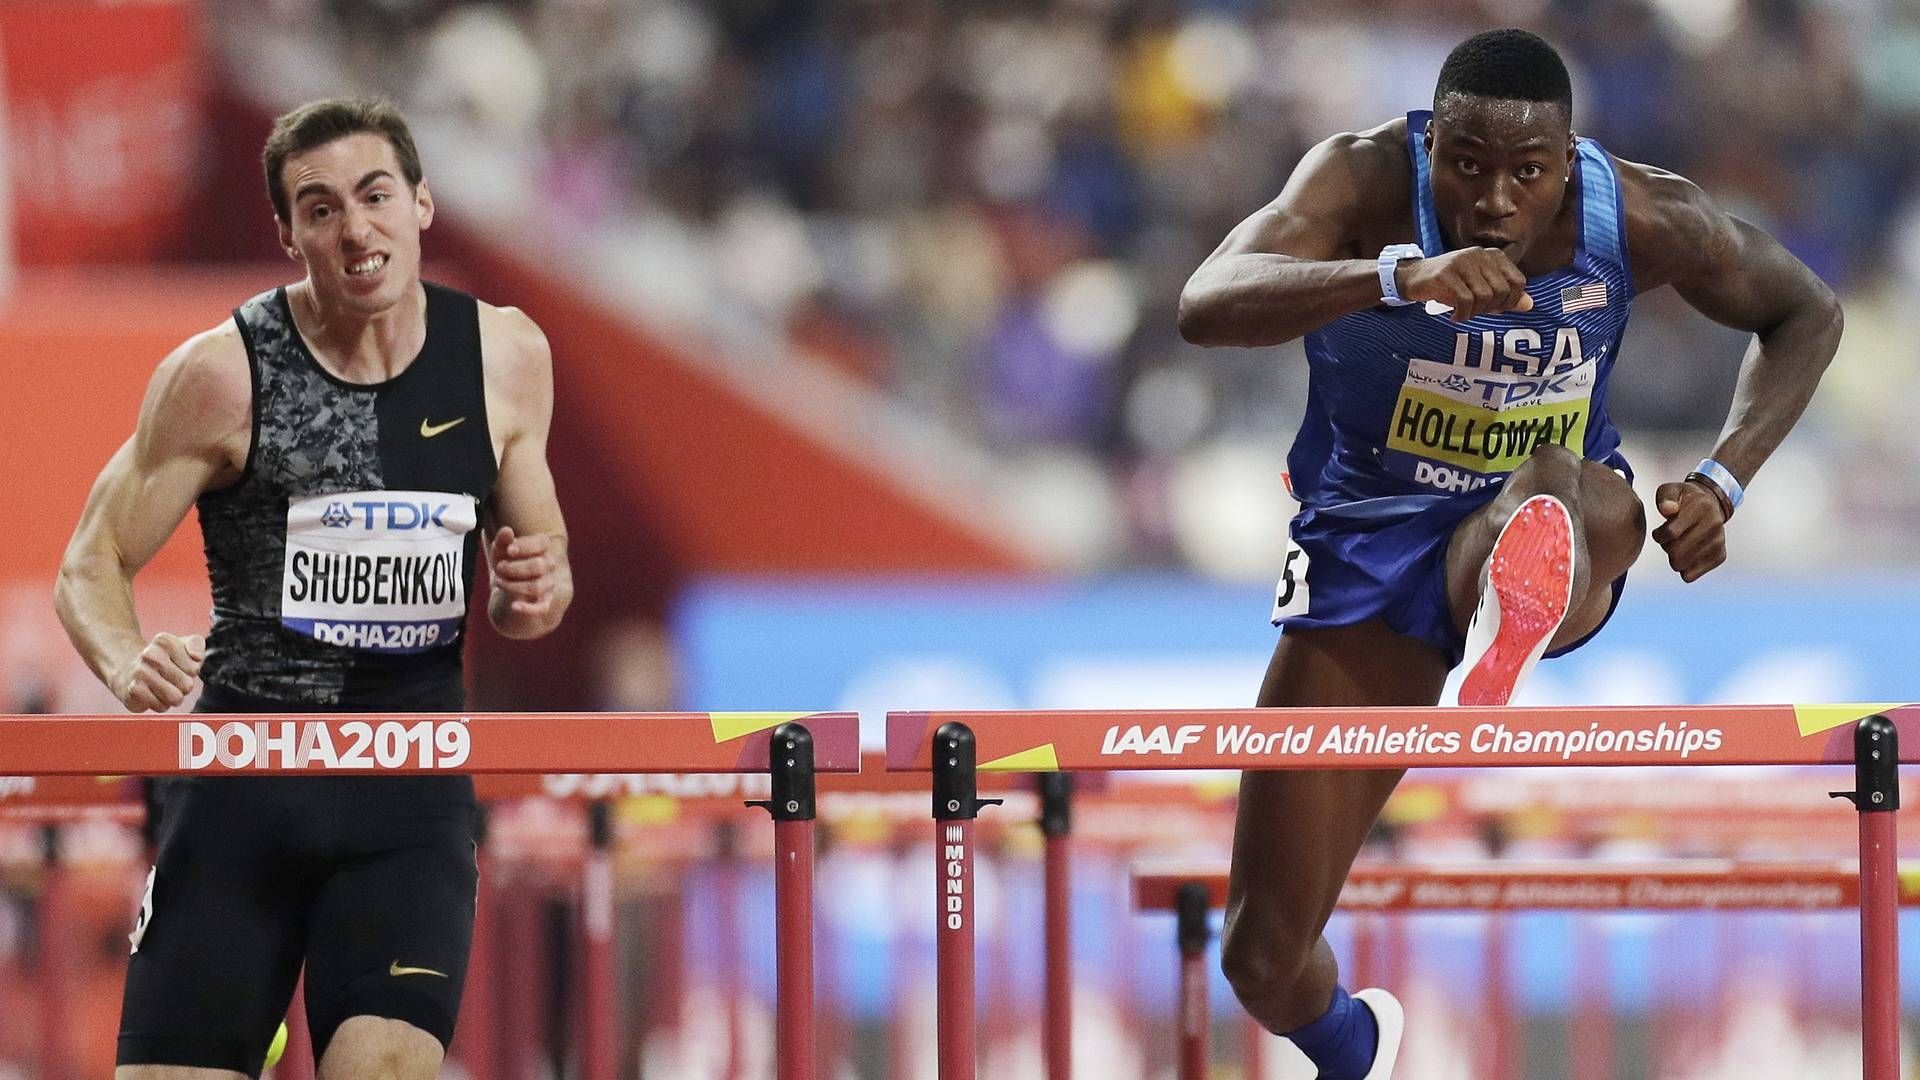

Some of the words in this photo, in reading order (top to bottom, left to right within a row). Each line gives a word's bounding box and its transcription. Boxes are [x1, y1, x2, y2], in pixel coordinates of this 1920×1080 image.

[1452, 326, 1584, 378] USA
[1473, 375, 1572, 405] TDK
[1395, 397, 1580, 460] HOLLOWAY
[352, 501, 450, 531] TDK
[289, 550, 458, 606] SHUBENKOV
[1277, 549, 1297, 608] 5
[313, 621, 441, 649] DOHA2019
[178, 720, 471, 770] DOHA2019
[1100, 724, 1206, 755] IAAF
[1215, 724, 1314, 755] World
[1317, 723, 1461, 754] Athletics
[1470, 720, 1723, 760] Championships
[945, 845, 964, 930] MONDO
